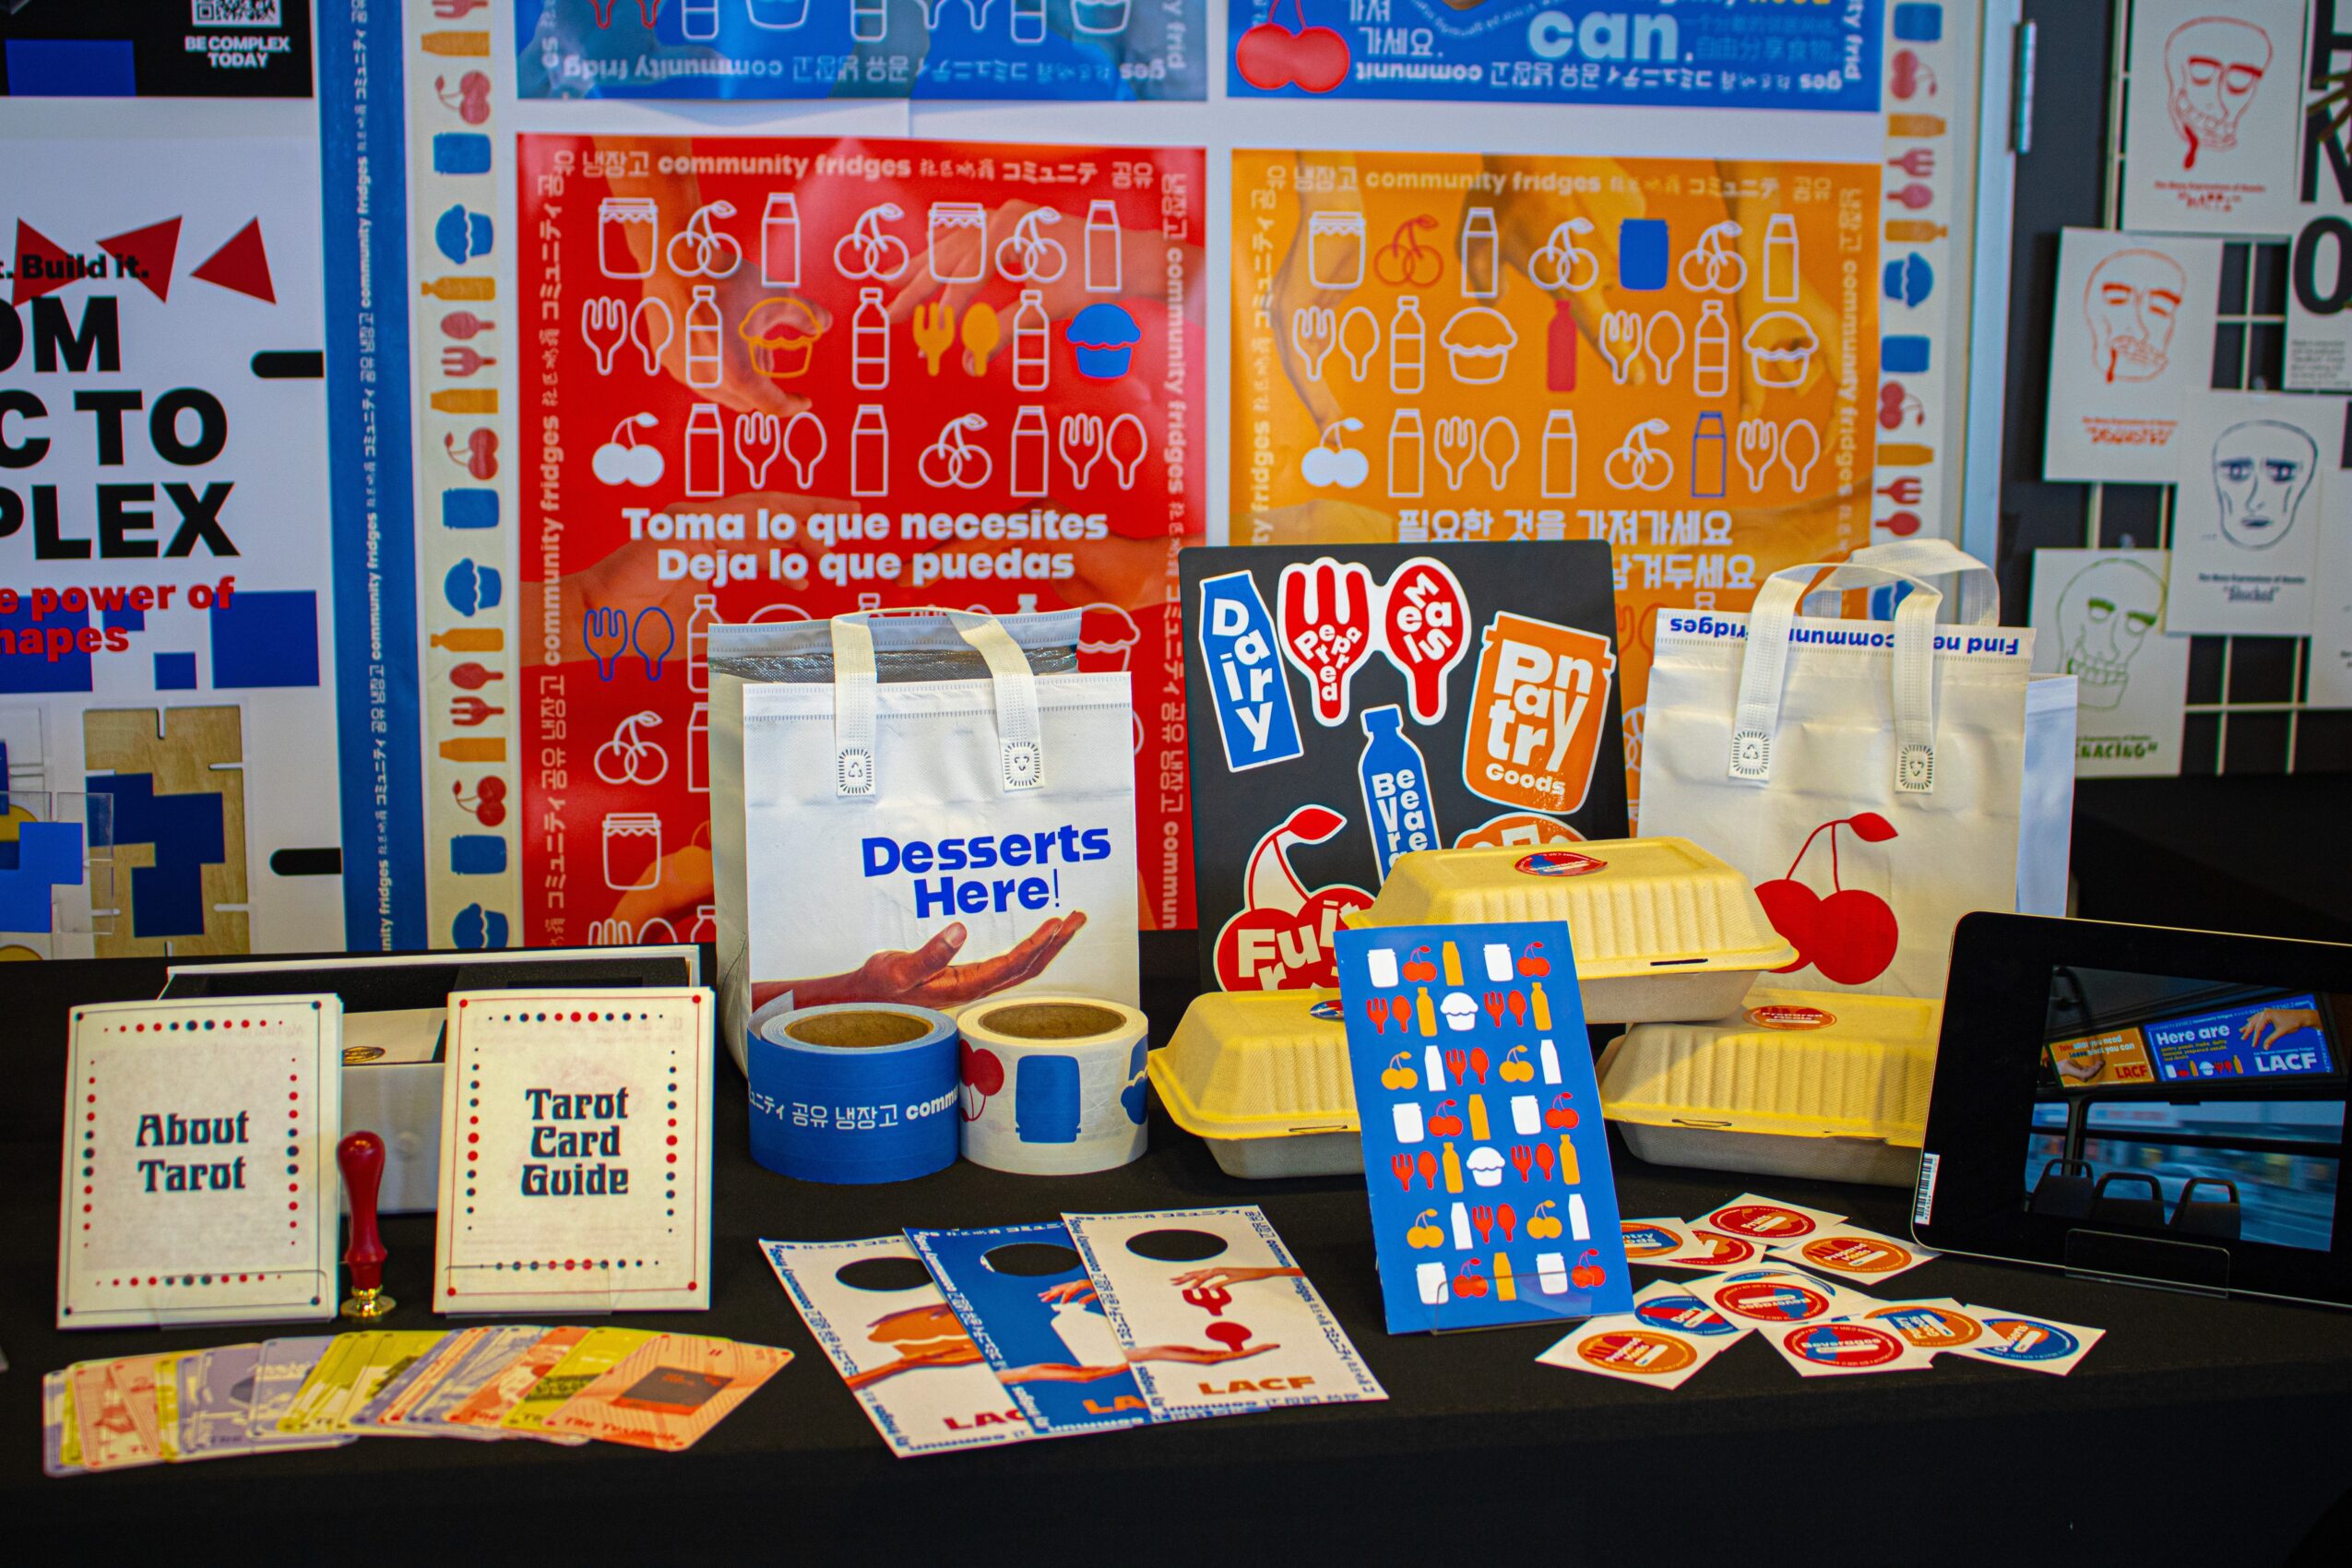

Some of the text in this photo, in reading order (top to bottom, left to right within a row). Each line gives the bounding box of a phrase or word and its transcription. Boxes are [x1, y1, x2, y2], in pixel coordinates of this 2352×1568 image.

[184, 37, 291, 53] BE COMPLEX
[208, 52, 269, 68] TODAY
[564, 55, 627, 81] fridg
[635, 54, 783, 79] community
[1120, 59, 1167, 80] ges
[1800, 69, 1842, 89] ges
[356, 157, 370, 214] fridges
[658, 154, 808, 179] community
[814, 152, 911, 181] fridges
[1111, 161, 1153, 189] 공유
[1366, 172, 1507, 196] community
[1512, 172, 1600, 196] fridges
[20, 255, 105, 279] Build
[113, 255, 149, 279] it.
[357, 218, 373, 308] community
[1164, 247, 1185, 393] community
[1837, 260, 1859, 401] community
[74, 387, 228, 467] TO
[1164, 400, 1187, 494] fridges
[540, 416, 564, 511] fridges
[1251, 421, 1274, 514] fridges
[1837, 407, 1858, 496] fridges
[365, 513, 379, 569] fridges
[622, 507, 1109, 548] Toma lo que necesites
[1577, 509, 1733, 546] 가져가세요
[658, 549, 1075, 588] Deja lo que puedas
[31, 583, 176, 622] power
[187, 576, 236, 611] of
[540, 517, 564, 667] community
[366, 572, 383, 660] community
[1396, 573, 1453, 664] Meals
[1294, 624, 1362, 703] Prepared
[1966, 636, 2018, 656] Find
[1211, 598, 1273, 753] Dairy
[540, 675, 565, 740] 냉장고
[1160, 702, 1184, 743] 공유
[541, 746, 567, 790] 공유
[1159, 751, 1184, 813] 냉장고
[1486, 764, 1565, 796] Goods
[861, 825, 1111, 877] Desserts
[914, 868, 1060, 919] Here!
[2156, 1025, 2230, 1045] Here are
[2115, 1065, 2148, 1078] LACF
[2254, 1052, 2317, 1073] LACF
[526, 1087, 629, 1121] Tarot
[791, 1101, 828, 1127] 공유
[835, 1104, 898, 1130] 냉장고
[135, 1111, 249, 1146] About
[530, 1125, 621, 1158] Card
[137, 1157, 246, 1193] Tarot
[521, 1163, 629, 1196] Guide
[1198, 1376, 1316, 1396] LACF
